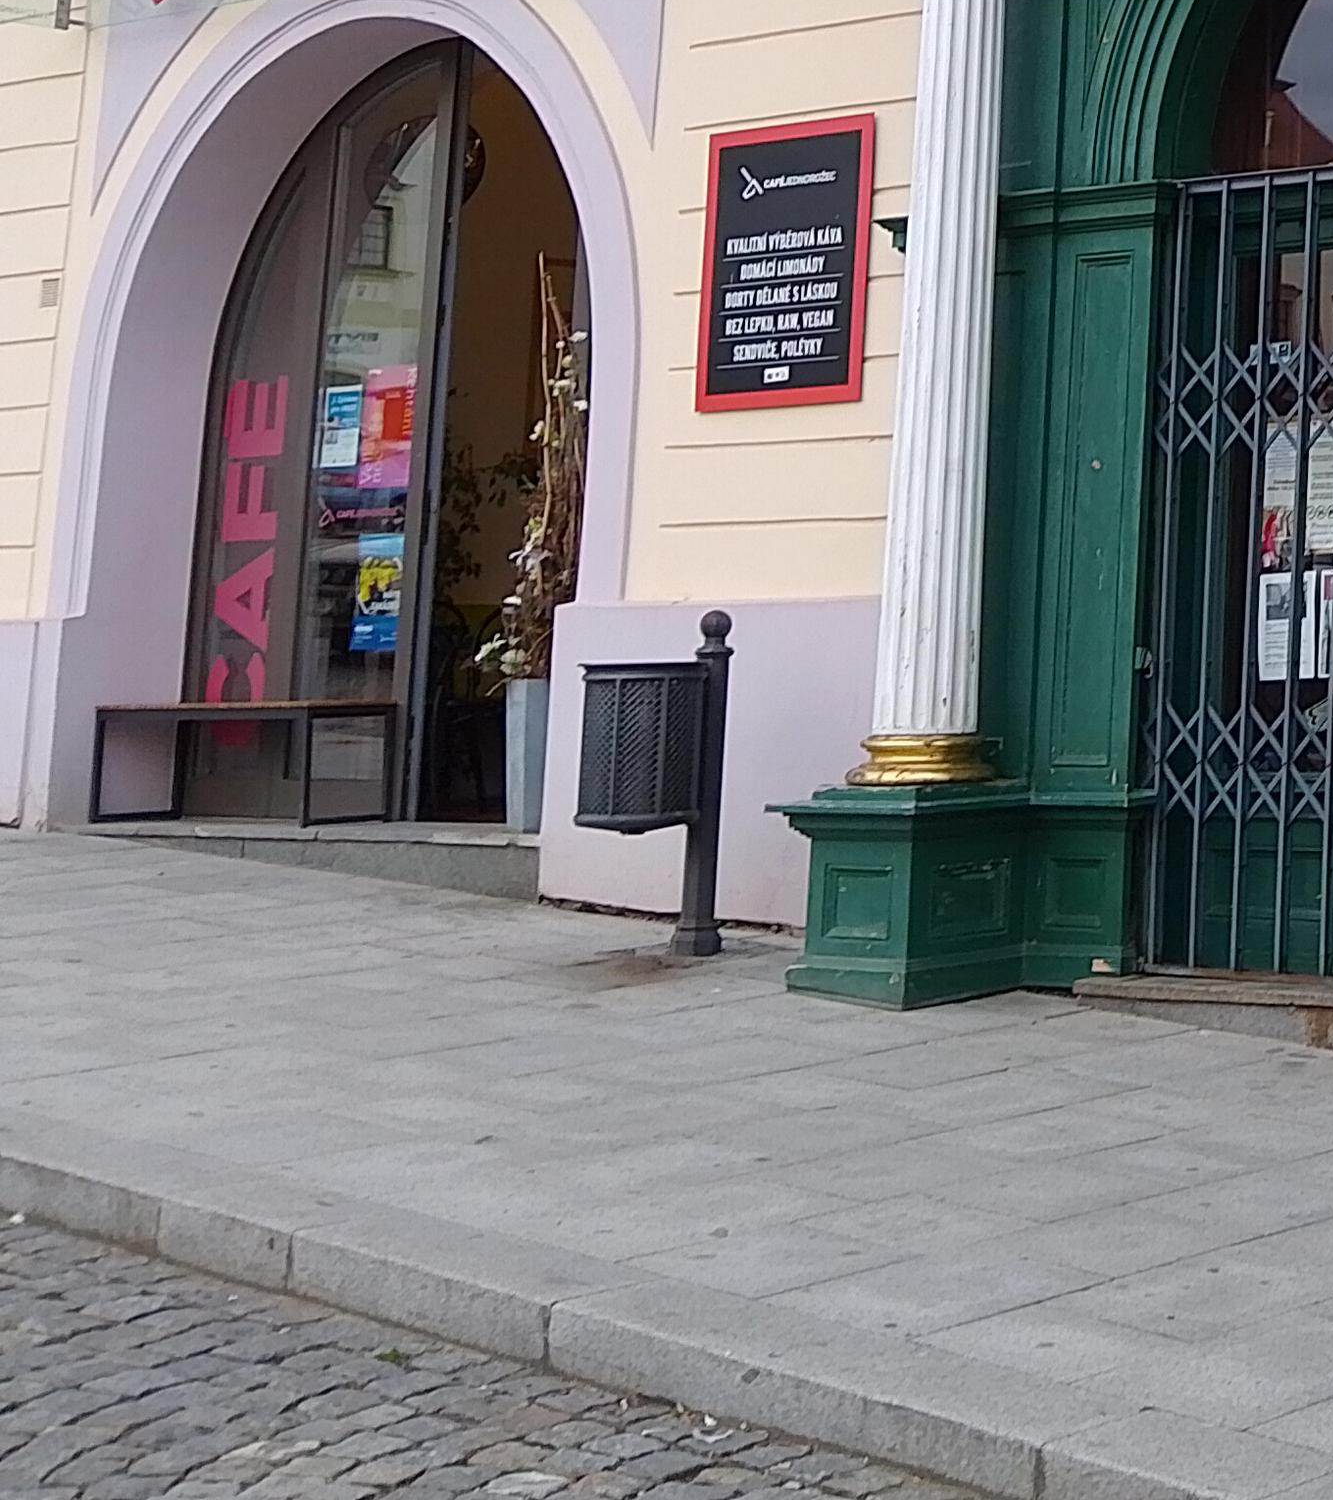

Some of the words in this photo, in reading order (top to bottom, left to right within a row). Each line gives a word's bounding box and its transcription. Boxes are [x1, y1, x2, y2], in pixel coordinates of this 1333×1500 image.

[726, 232, 767, 255] KVALITNÍ
[769, 227, 815, 251] VÝBĚROVÁ
[817, 225, 843, 246] KÁVA
[740, 257, 777, 280] DOMÁCÍ
[778, 255, 825, 276] LIMONÁDY
[725, 289, 755, 309] DORTY
[756, 284, 791, 306] DĚLANÉ
[792, 285, 799, 302] S
[800, 281, 838, 301] LÁSKOU
[725, 317, 744, 336] BEZ
[802, 308, 834, 328] VEGAN
[781, 337, 823, 358] POLÉVKY
